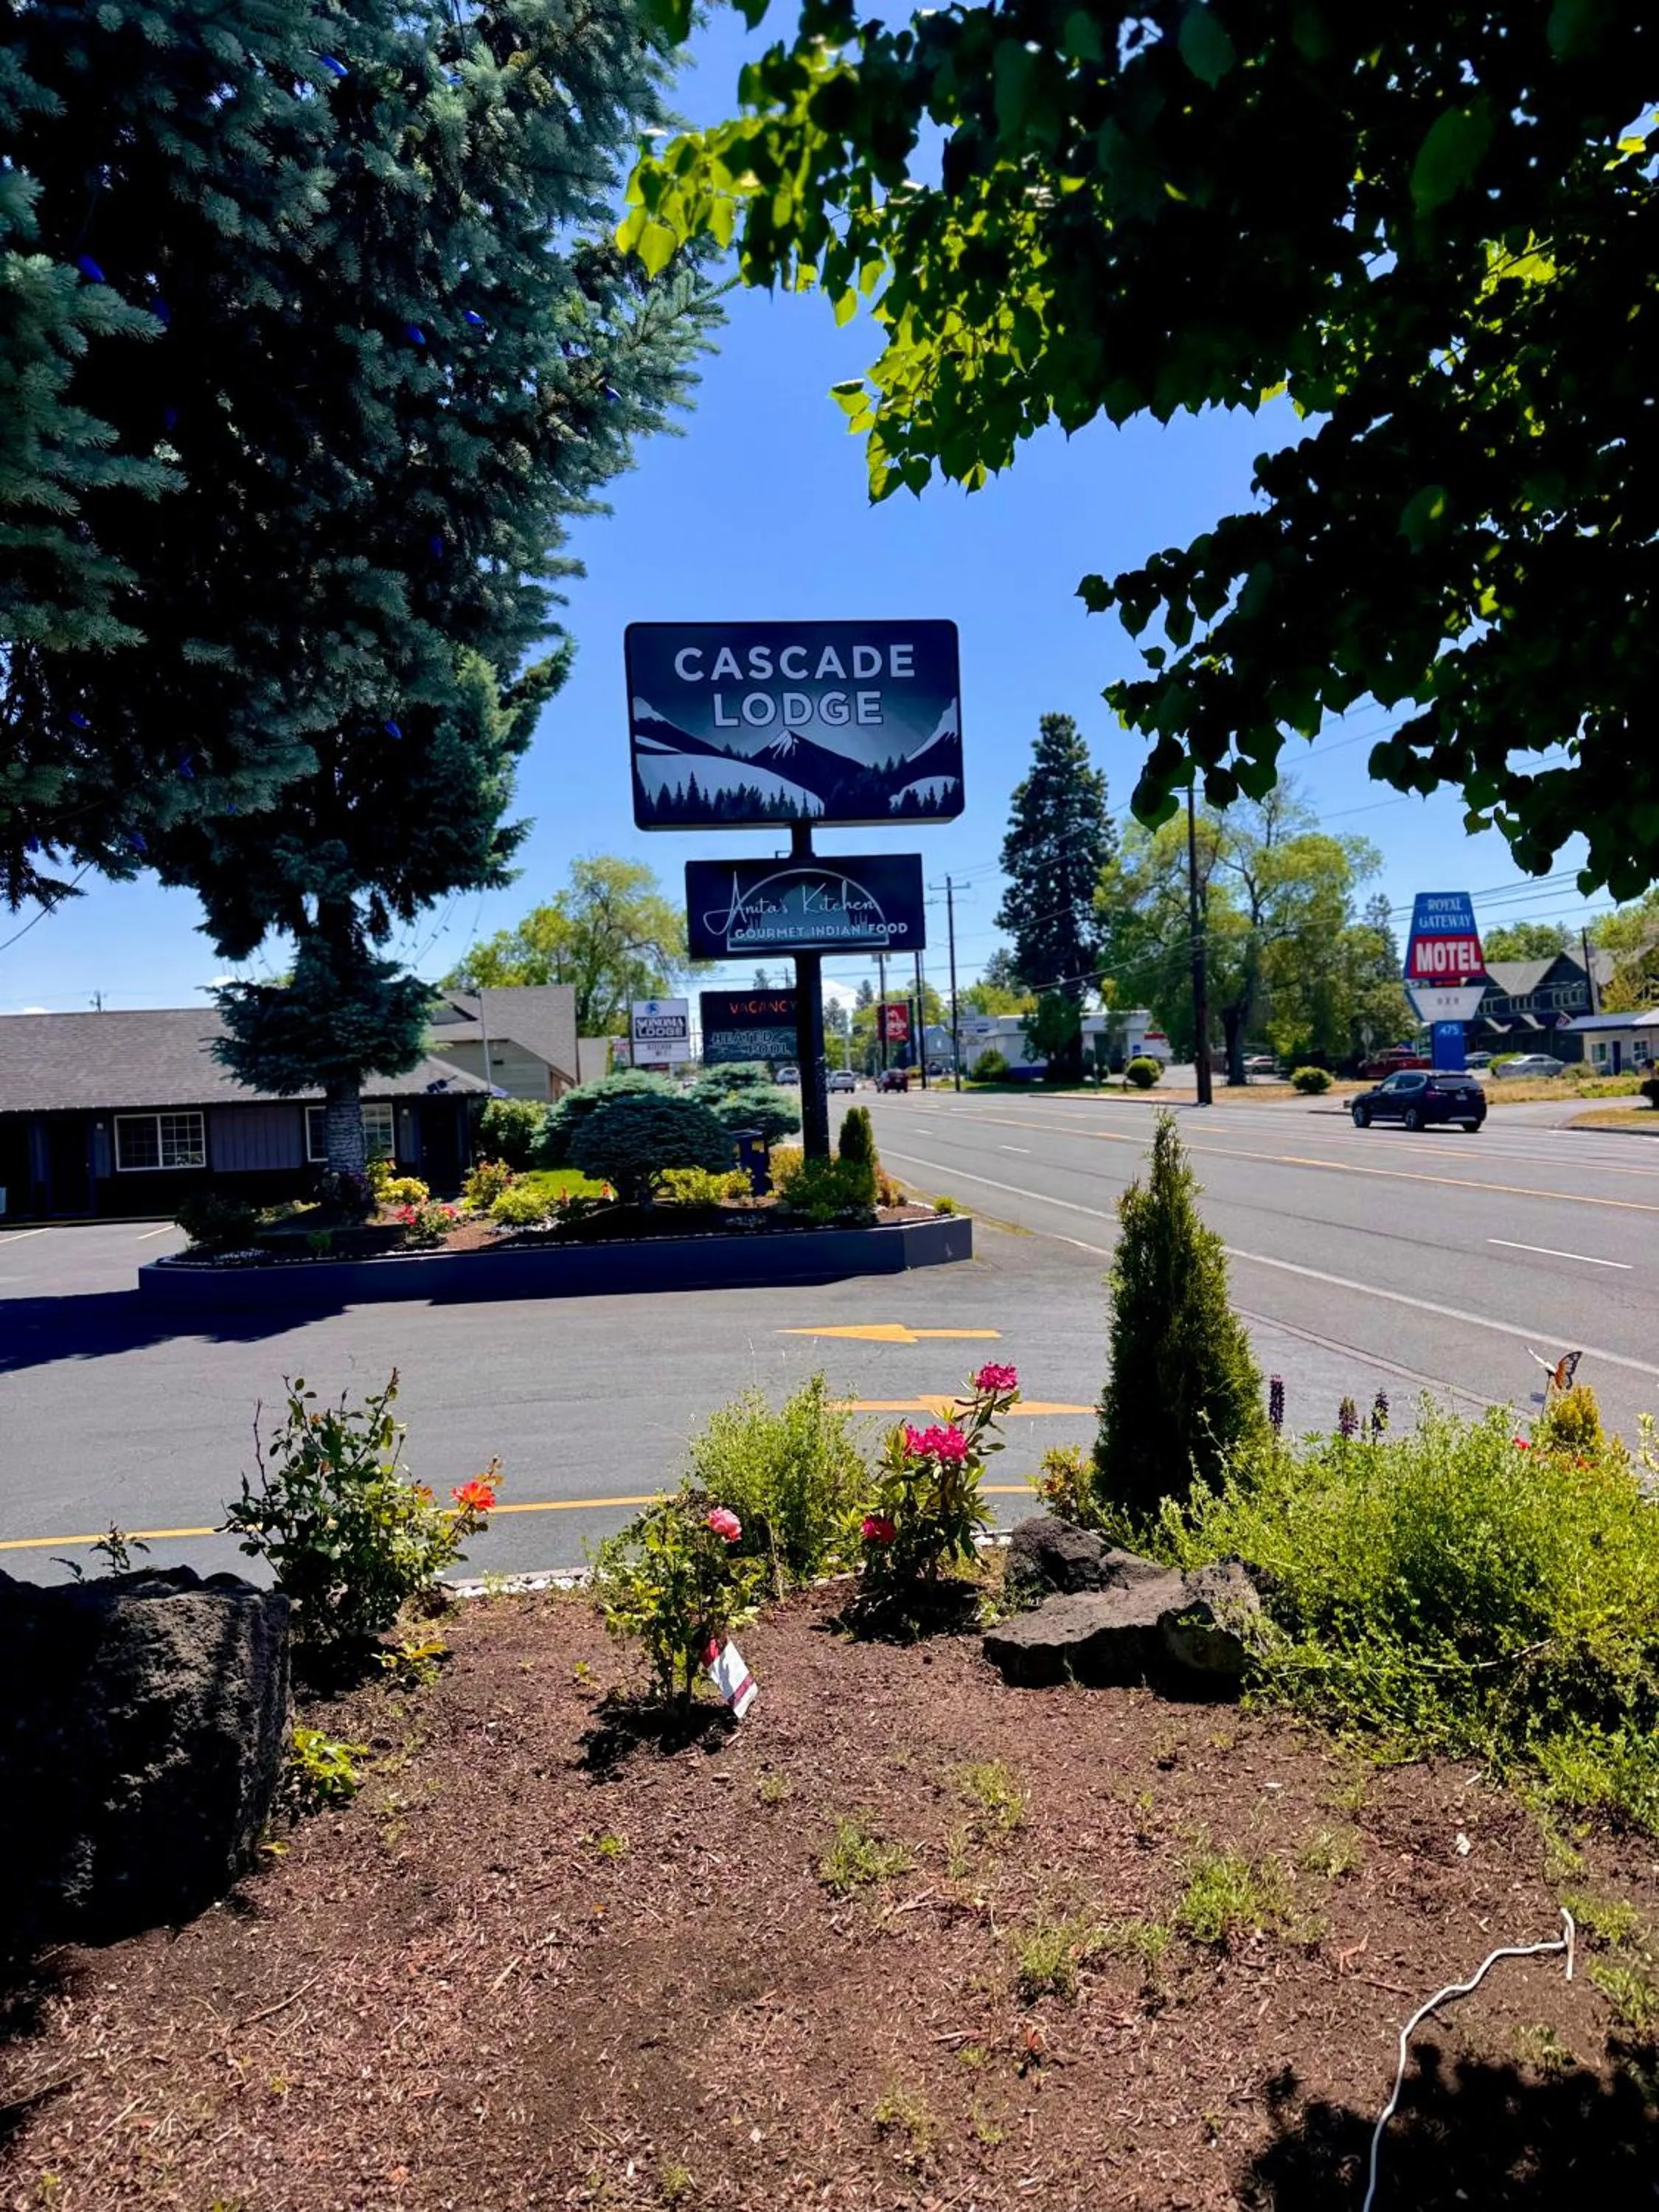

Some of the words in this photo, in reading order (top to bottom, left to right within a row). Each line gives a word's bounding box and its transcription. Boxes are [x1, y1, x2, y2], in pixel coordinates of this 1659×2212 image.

[674, 644, 915, 681] CASCADE
[713, 691, 884, 726] LODGE
[703, 870, 788, 935] Anita's
[802, 878, 874, 914] Kitchen
[1427, 897, 1463, 912] ROYAL
[734, 926, 804, 939] GOURMET
[810, 925, 862, 937] INDIAN
[868, 922, 908, 934] FOOD
[1418, 914, 1472, 929] GATEWAY
[1415, 942, 1481, 973] MOTEL
[638, 1026, 684, 1037] LODGE
